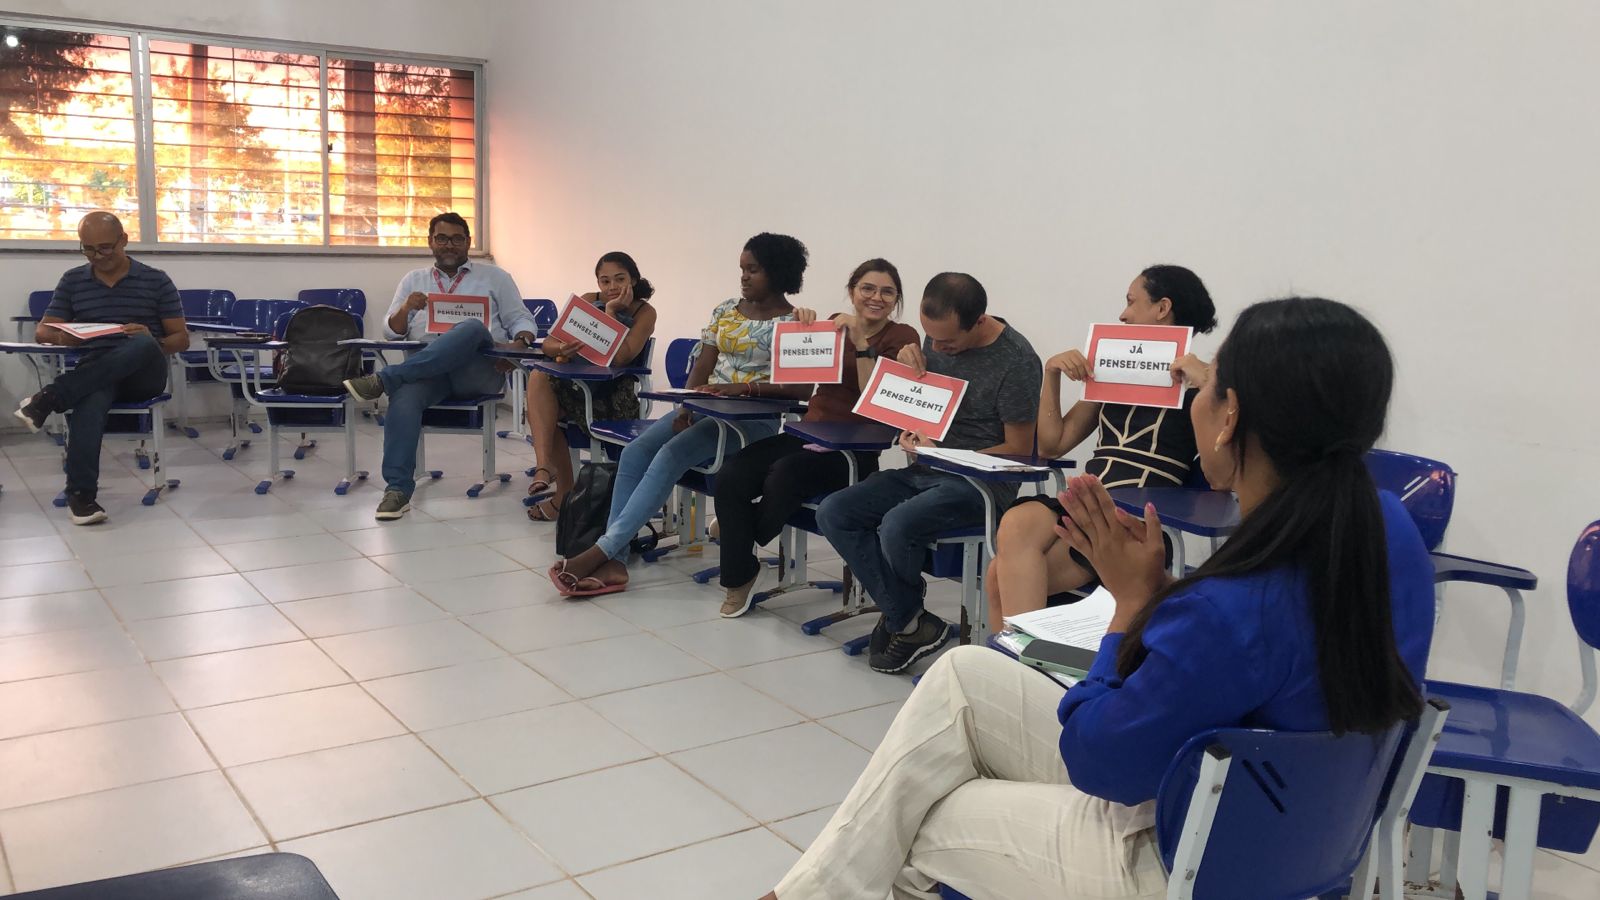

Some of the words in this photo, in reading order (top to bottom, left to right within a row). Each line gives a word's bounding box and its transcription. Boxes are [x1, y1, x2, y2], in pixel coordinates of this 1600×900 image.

[589, 320, 599, 329] JÁ
[569, 318, 611, 347] PENSEI/SENTI
[802, 335, 813, 344] JÁ
[783, 347, 833, 356] PENSEI/SENTI
[1129, 343, 1143, 354] JÁ
[1099, 358, 1171, 372] PENSEI/SENTI
[910, 385, 923, 395] JÁ
[880, 388, 943, 412] PENSEI/SENTI
